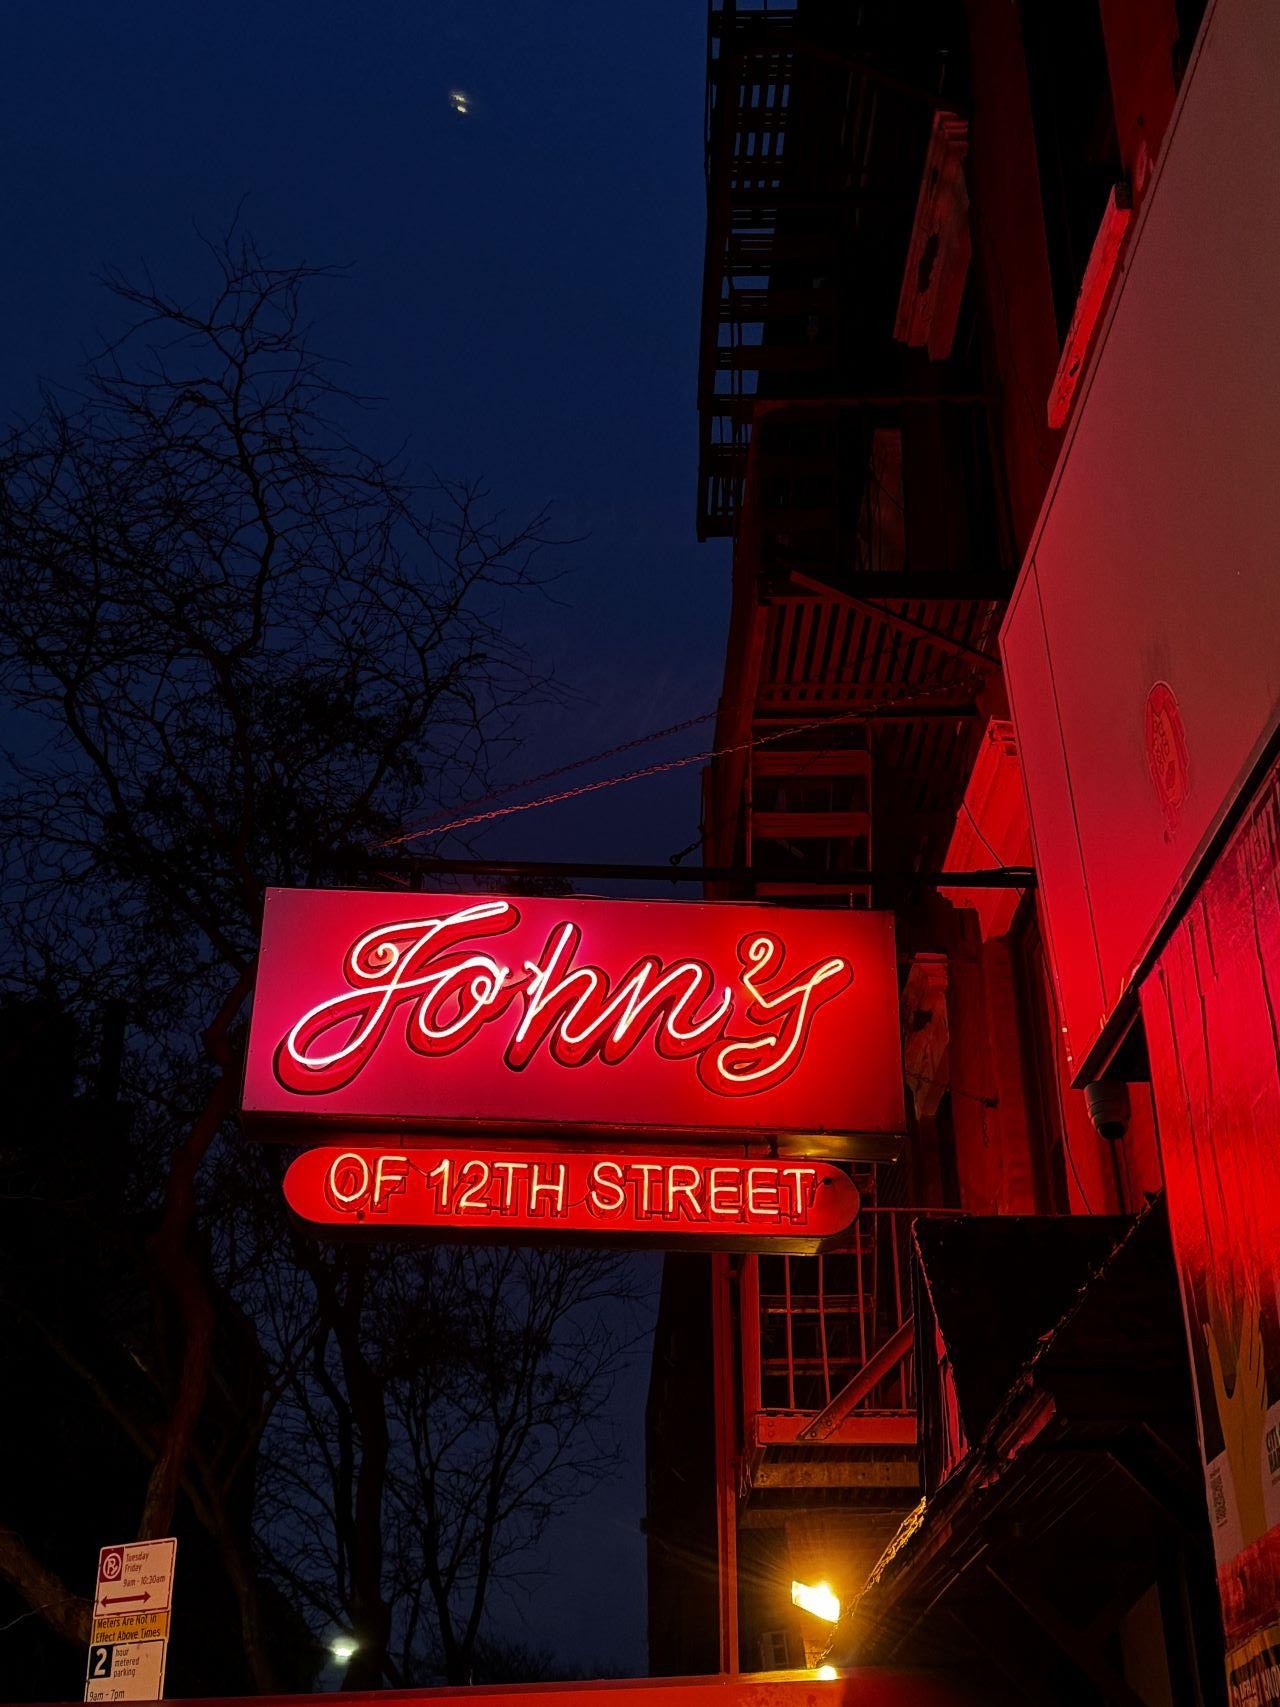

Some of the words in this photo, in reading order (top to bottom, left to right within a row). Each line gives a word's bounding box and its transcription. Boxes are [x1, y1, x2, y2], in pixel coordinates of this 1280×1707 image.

[275, 902, 853, 1095] John's
[325, 1152, 408, 1215] OF
[430, 1159, 571, 1217] 12TH
[588, 1162, 816, 1226] STREET
[126, 1552, 149, 1562] Tuesday
[125, 1564, 142, 1574] Friday
[123, 1578, 136, 1587] 9am
[141, 1575, 165, 1585] 10:30am
[97, 1618, 120, 1629] Meters
[122, 1616, 134, 1626] Are
[135, 1615, 148, 1625] Not
[95, 1633, 115, 1643] Effect
[117, 1630, 139, 1641] Above
[141, 1628, 161, 1639] Times
[115, 1648, 129, 1657] hour
[94, 1648, 107, 1676] 2
[114, 1657, 140, 1667] metered
[113, 1668, 136, 1678] parking
[89, 1691, 104, 1701] 9am
[110, 1689, 125, 1702] 7pm
